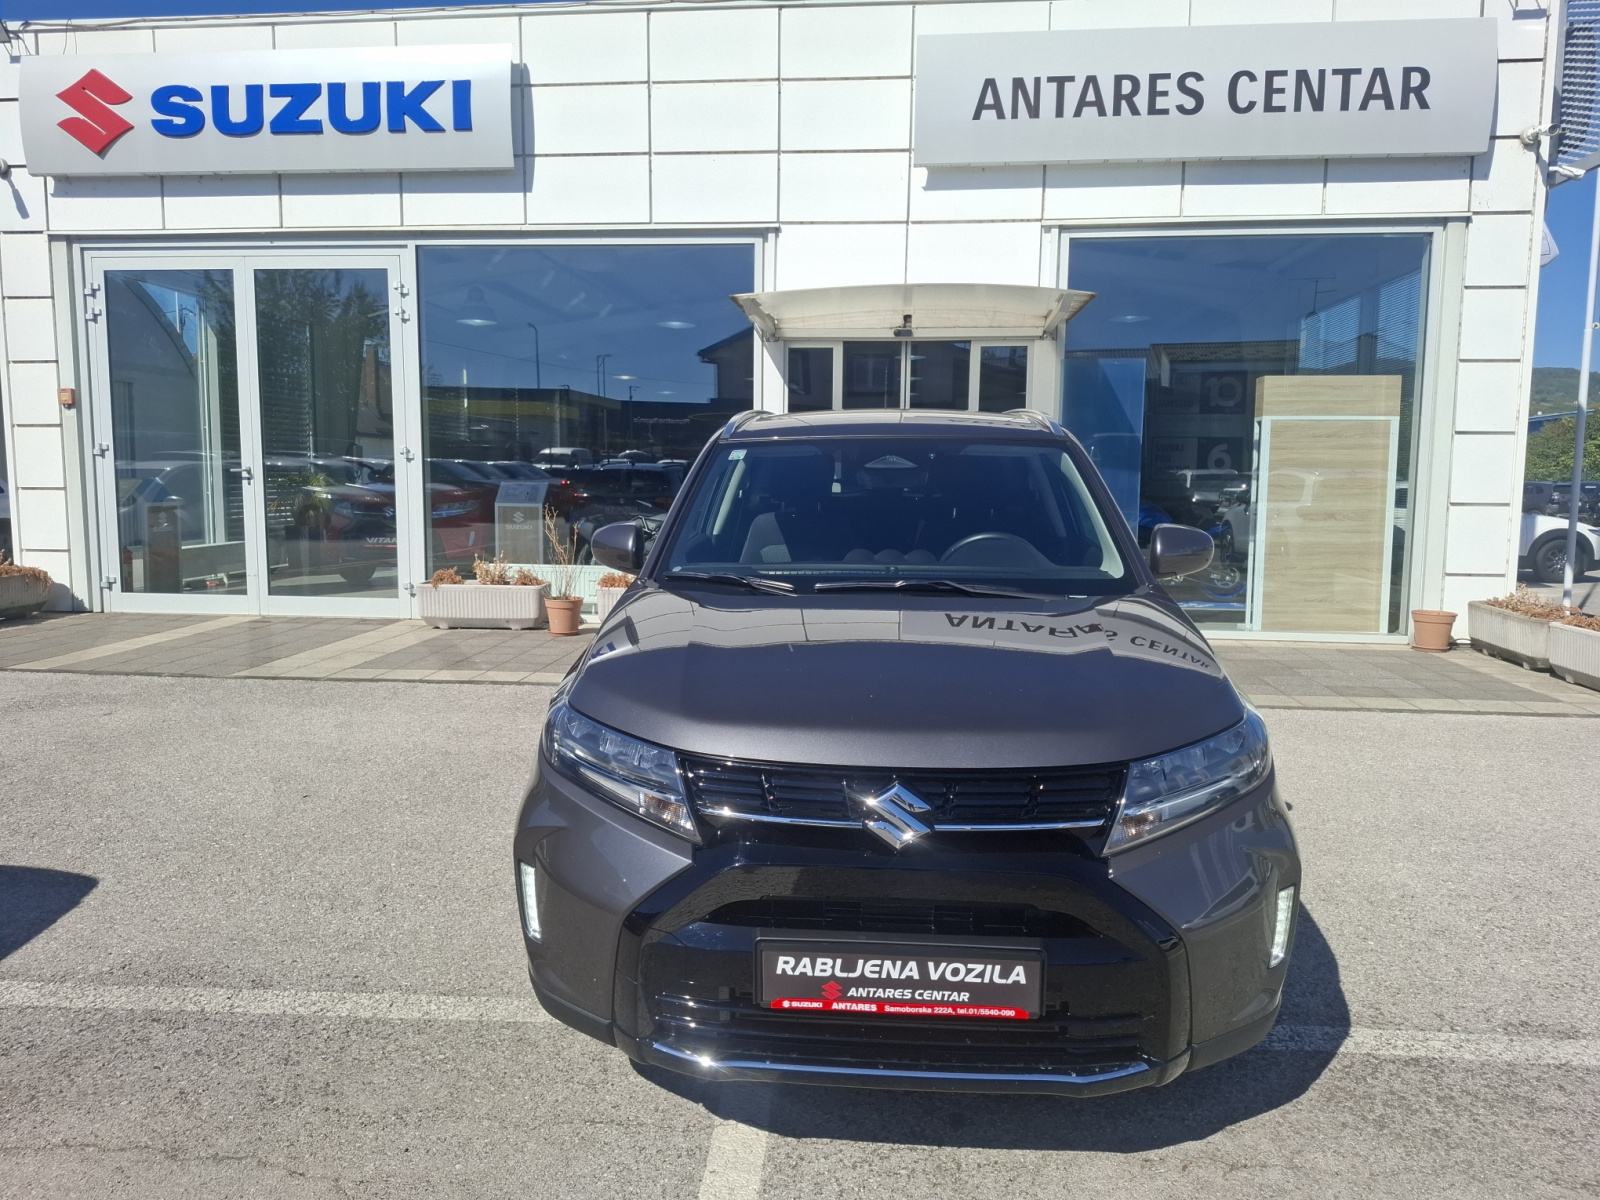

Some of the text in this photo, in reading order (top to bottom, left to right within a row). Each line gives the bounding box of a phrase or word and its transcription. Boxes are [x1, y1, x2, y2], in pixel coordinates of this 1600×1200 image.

[972, 66, 1432, 120] ANTARES CENTAR
[150, 80, 473, 138] SUZUKI
[776, 956, 1027, 984] RABLJENA VOZILA
[831, 1002, 878, 1012] ANTARES
[884, 1005, 932, 1014] Samoborska
[934, 1007, 955, 1015] 222A,
[847, 987, 970, 1002] ANTARES CENTAR
